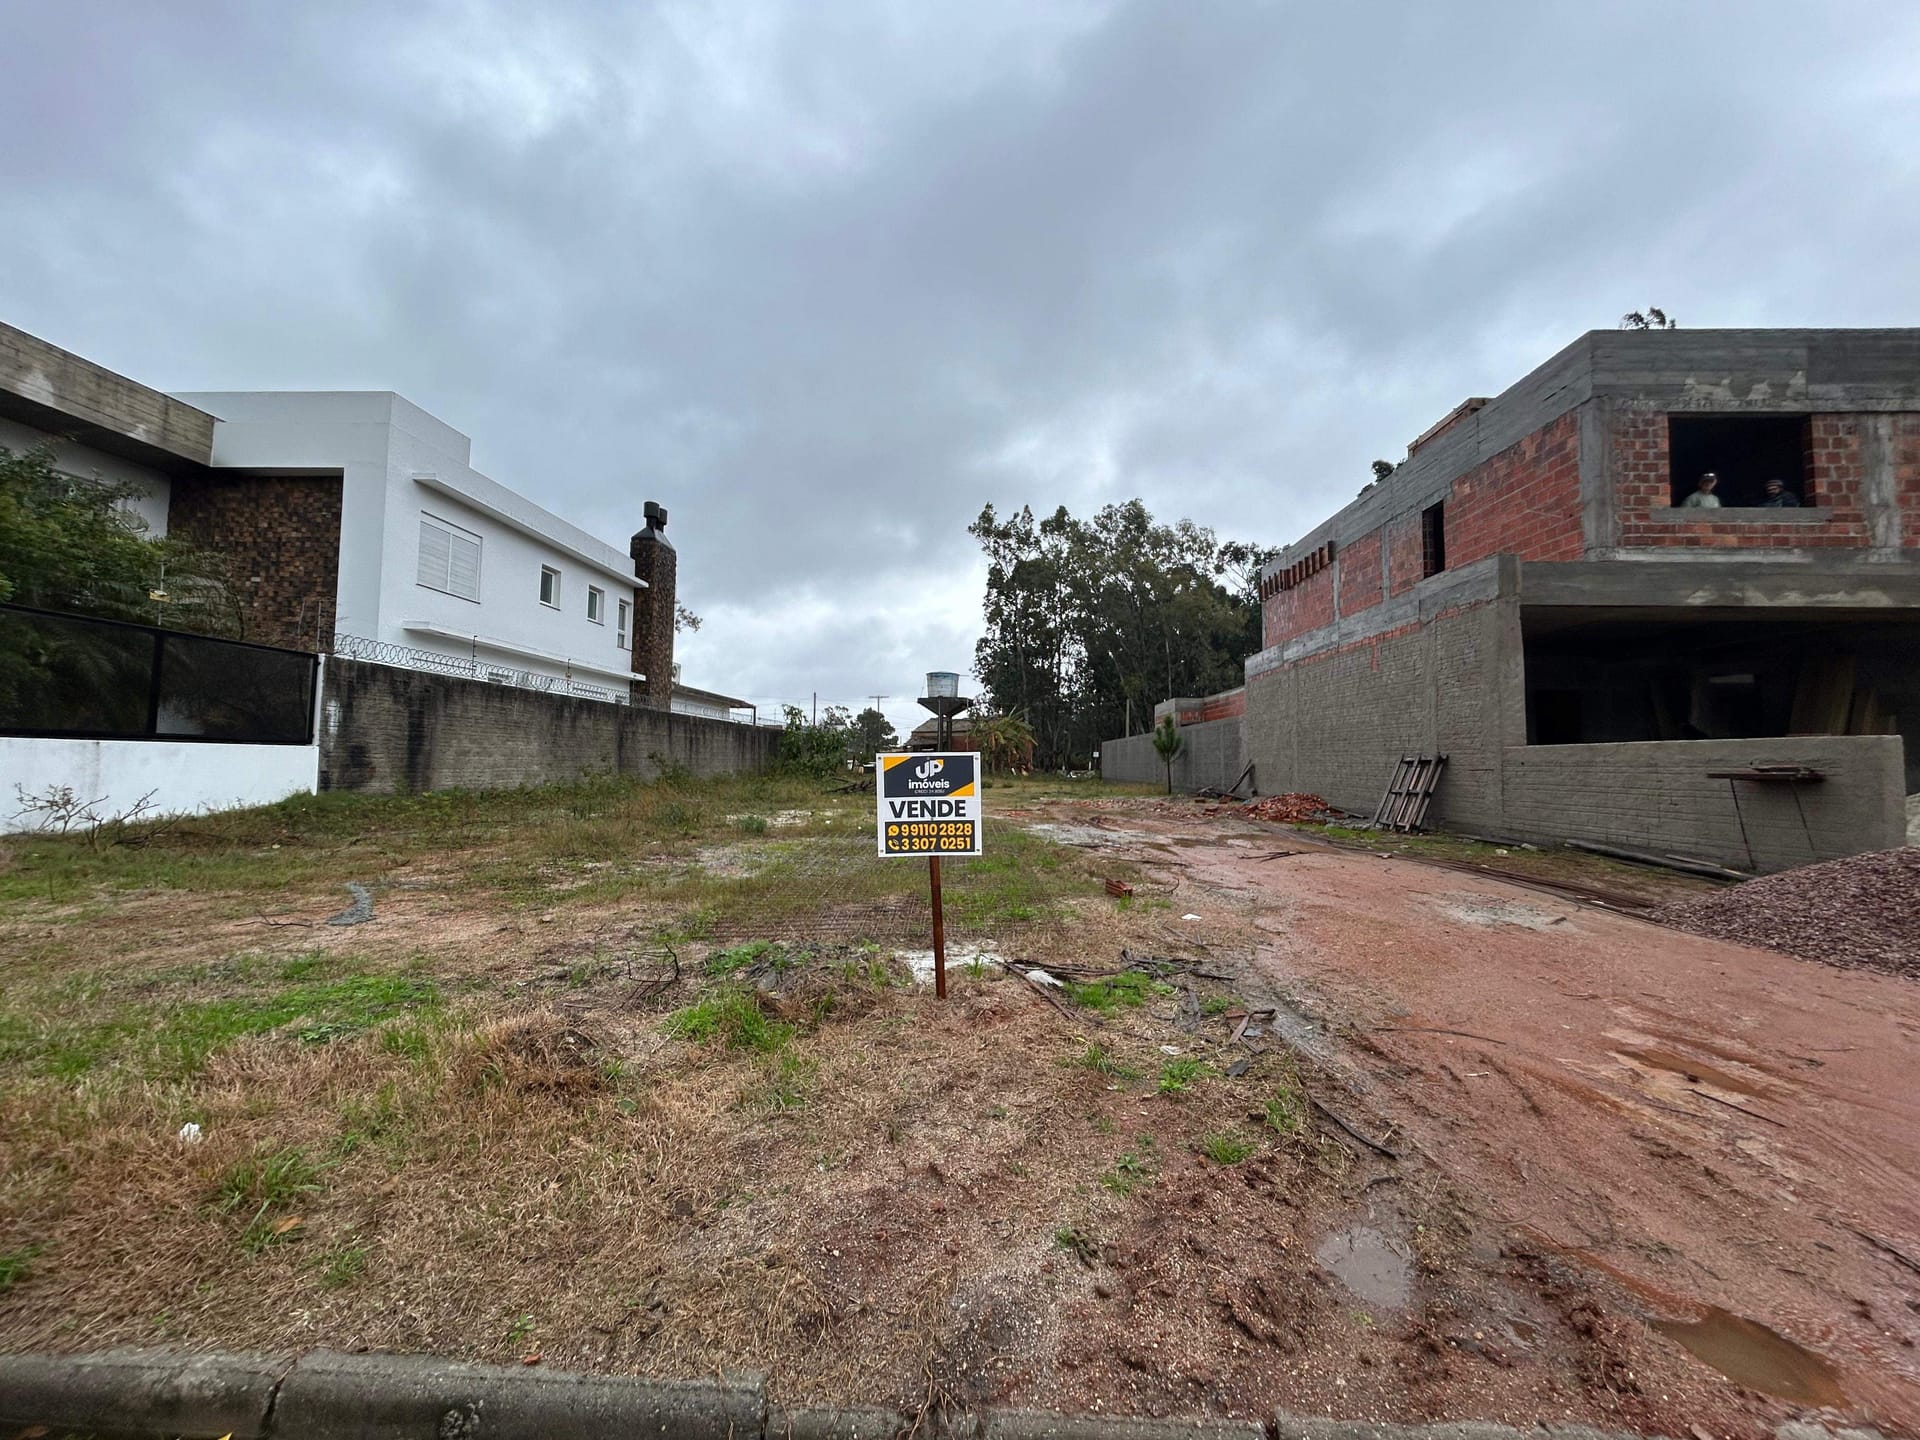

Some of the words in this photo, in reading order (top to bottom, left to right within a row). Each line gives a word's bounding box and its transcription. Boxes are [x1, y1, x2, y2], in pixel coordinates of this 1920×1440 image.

[908, 779, 950, 789] imóveis
[889, 800, 966, 819] VENDE
[939, 823, 972, 836] 2828
[940, 837, 971, 849] 0251
